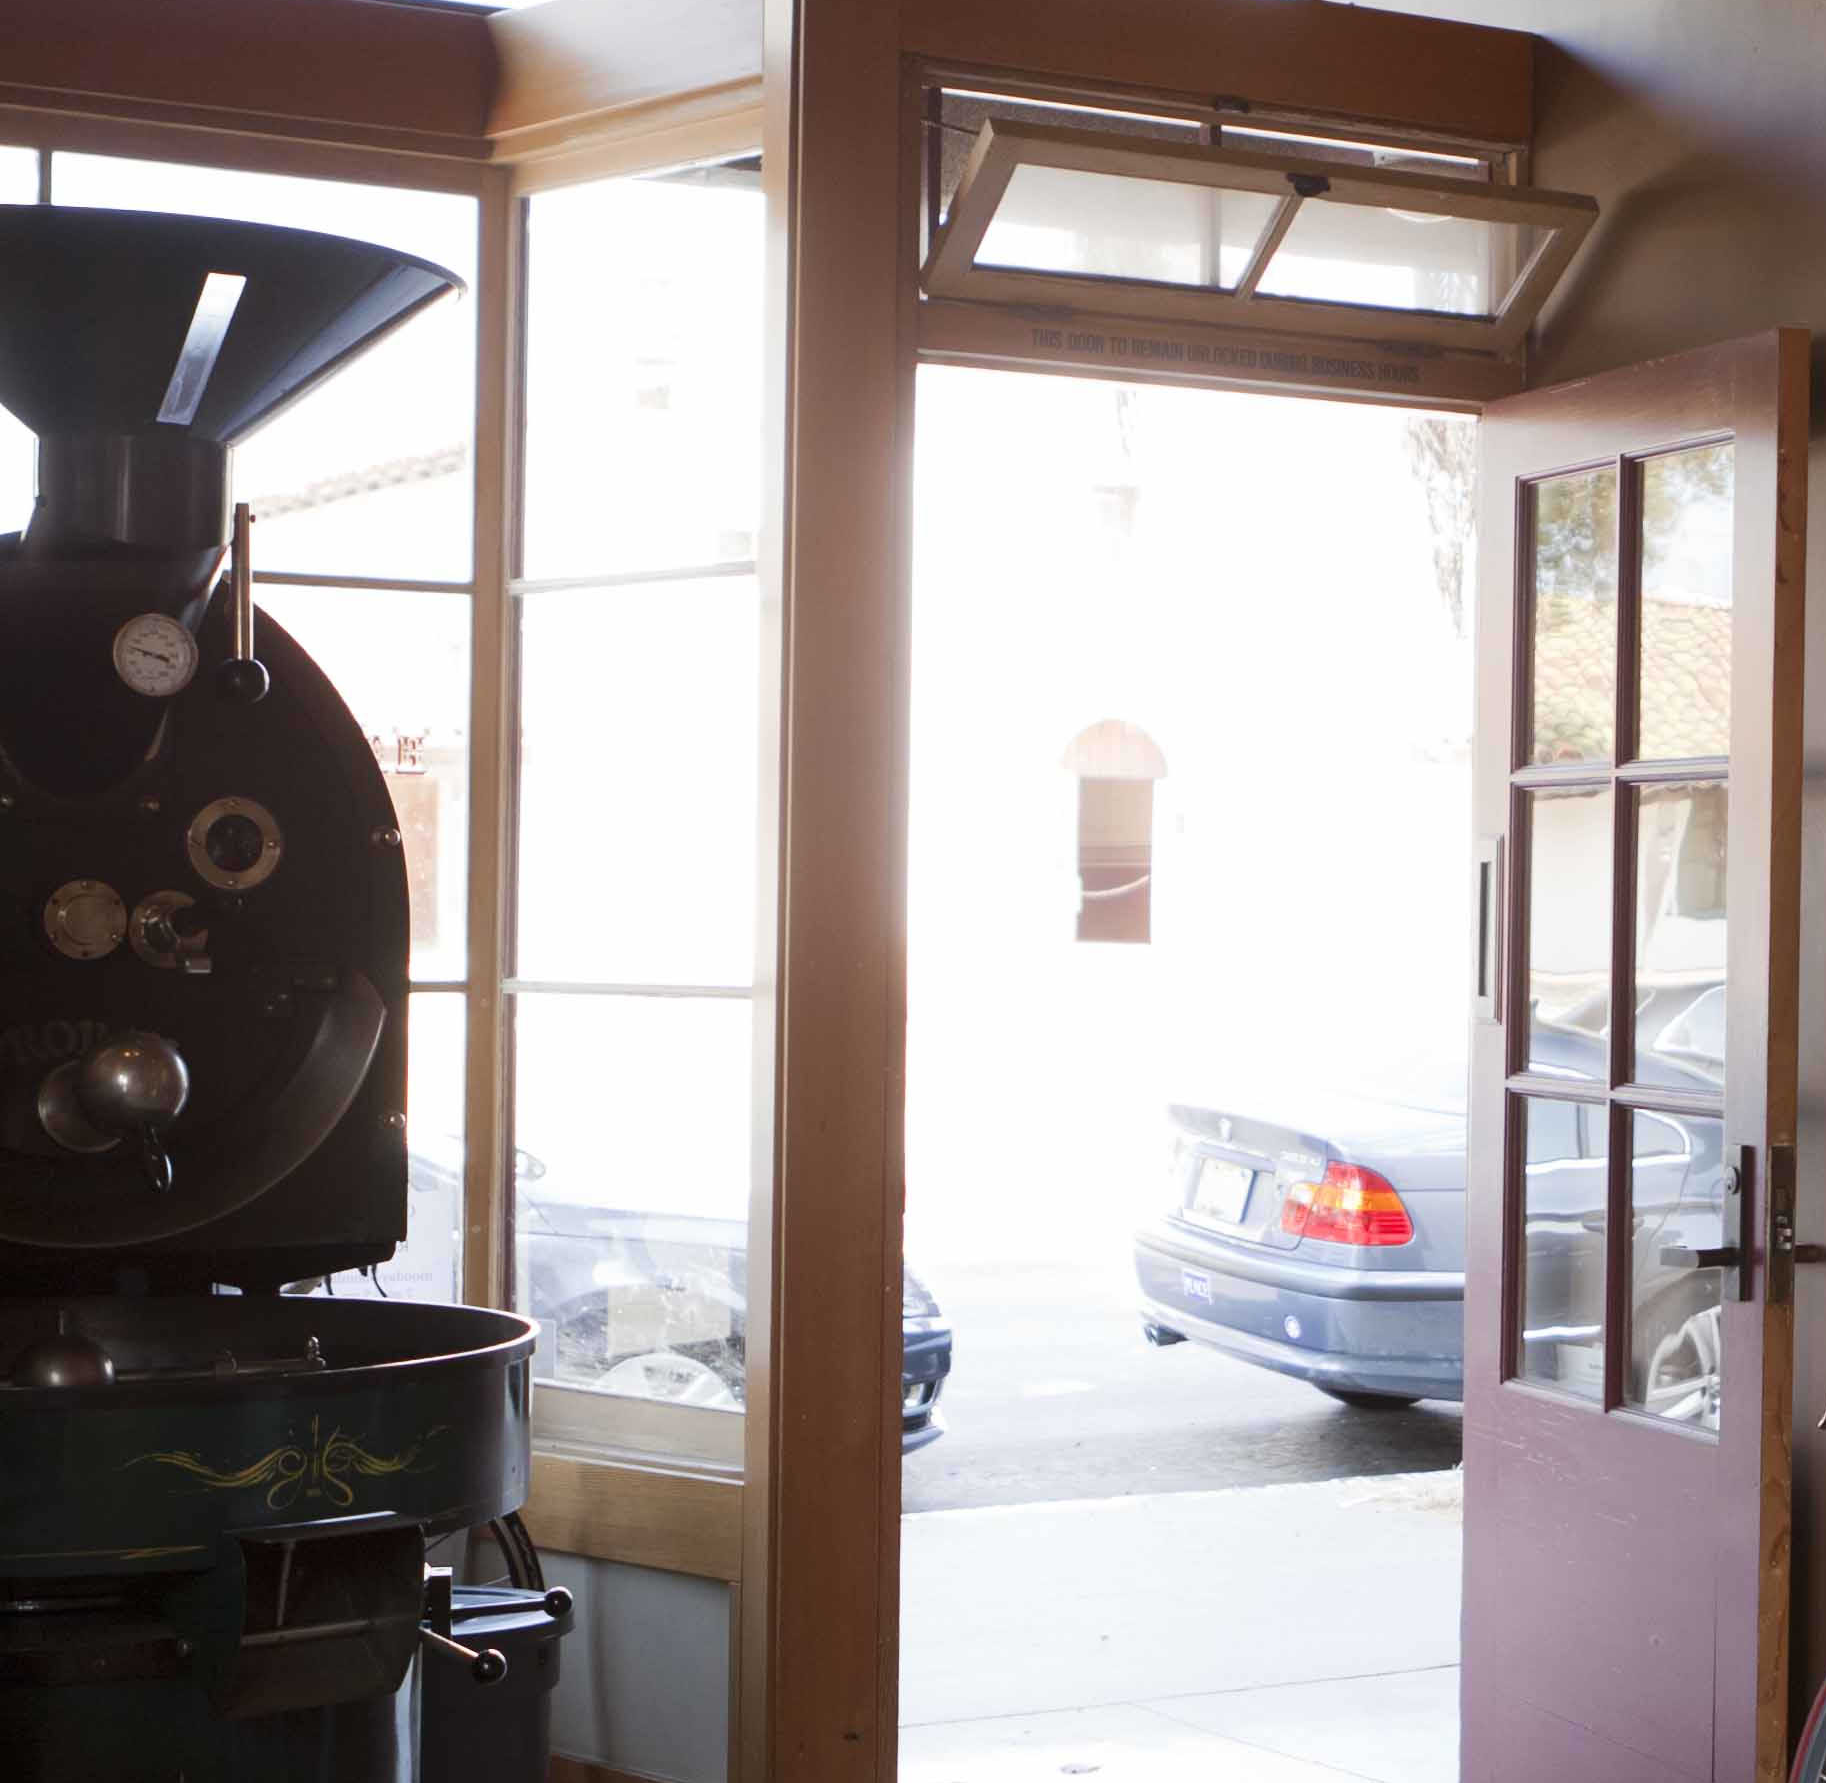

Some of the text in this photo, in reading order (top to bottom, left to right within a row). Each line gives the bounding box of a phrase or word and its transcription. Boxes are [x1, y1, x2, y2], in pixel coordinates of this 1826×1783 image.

[1031, 329, 1063, 351] THIS
[1067, 333, 1105, 354] DOOR
[1110, 336, 1127, 355] TO
[1311, 356, 1376, 380] BUSINESS
[1379, 363, 1420, 385] HOURS
